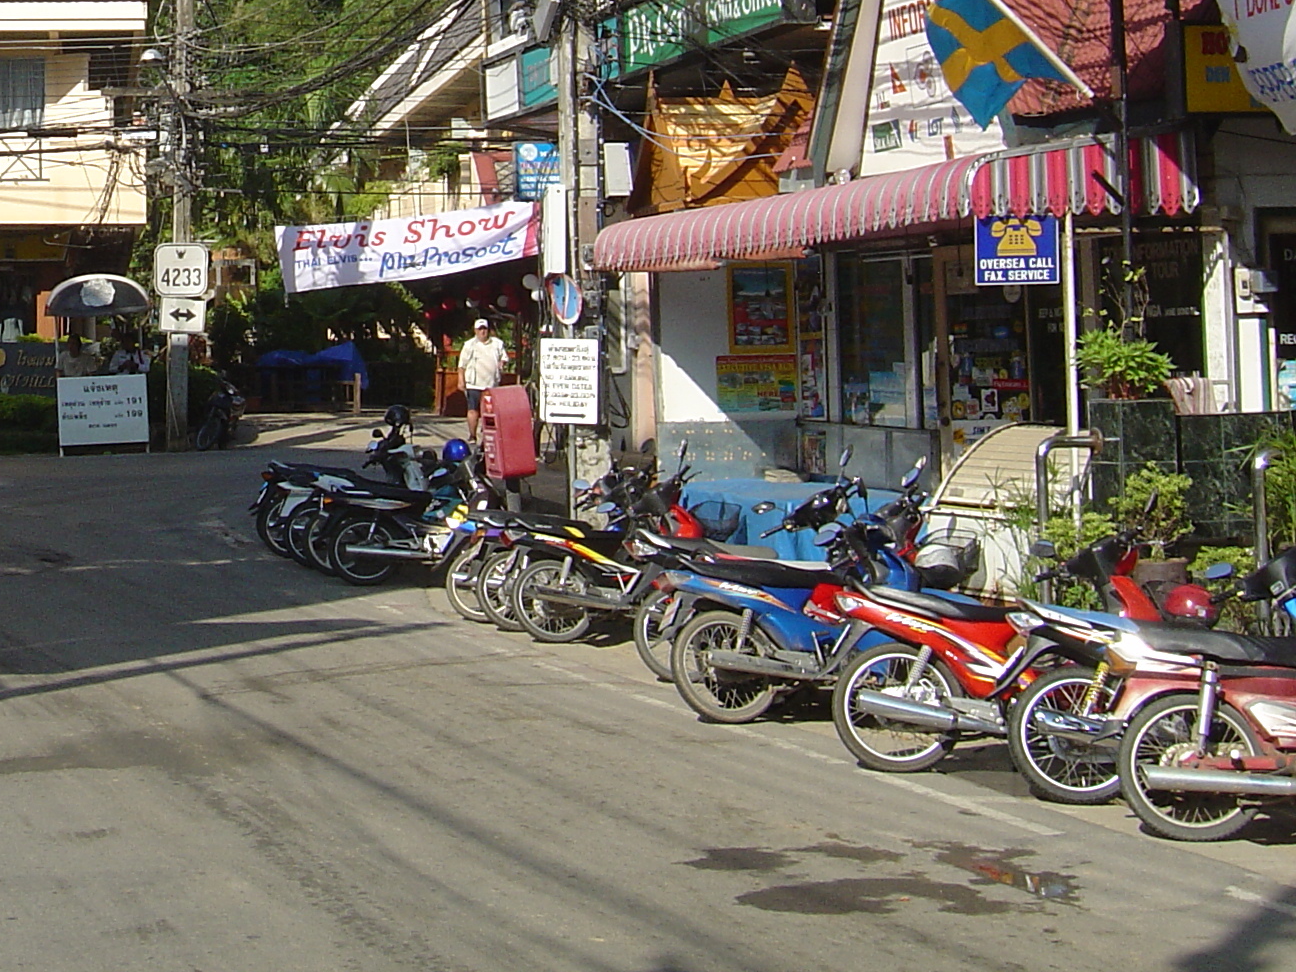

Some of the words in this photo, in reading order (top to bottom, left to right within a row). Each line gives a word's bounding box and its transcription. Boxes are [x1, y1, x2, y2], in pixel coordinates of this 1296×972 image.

[292, 226, 387, 252] Elvis
[403, 210, 516, 244] Show
[295, 258, 322, 270] THAI
[979, 258, 1025, 270] OVERSEA
[1029, 257, 1054, 268] CALL
[161, 268, 201, 286] 4233
[1008, 269, 1050, 280] SERVICE
